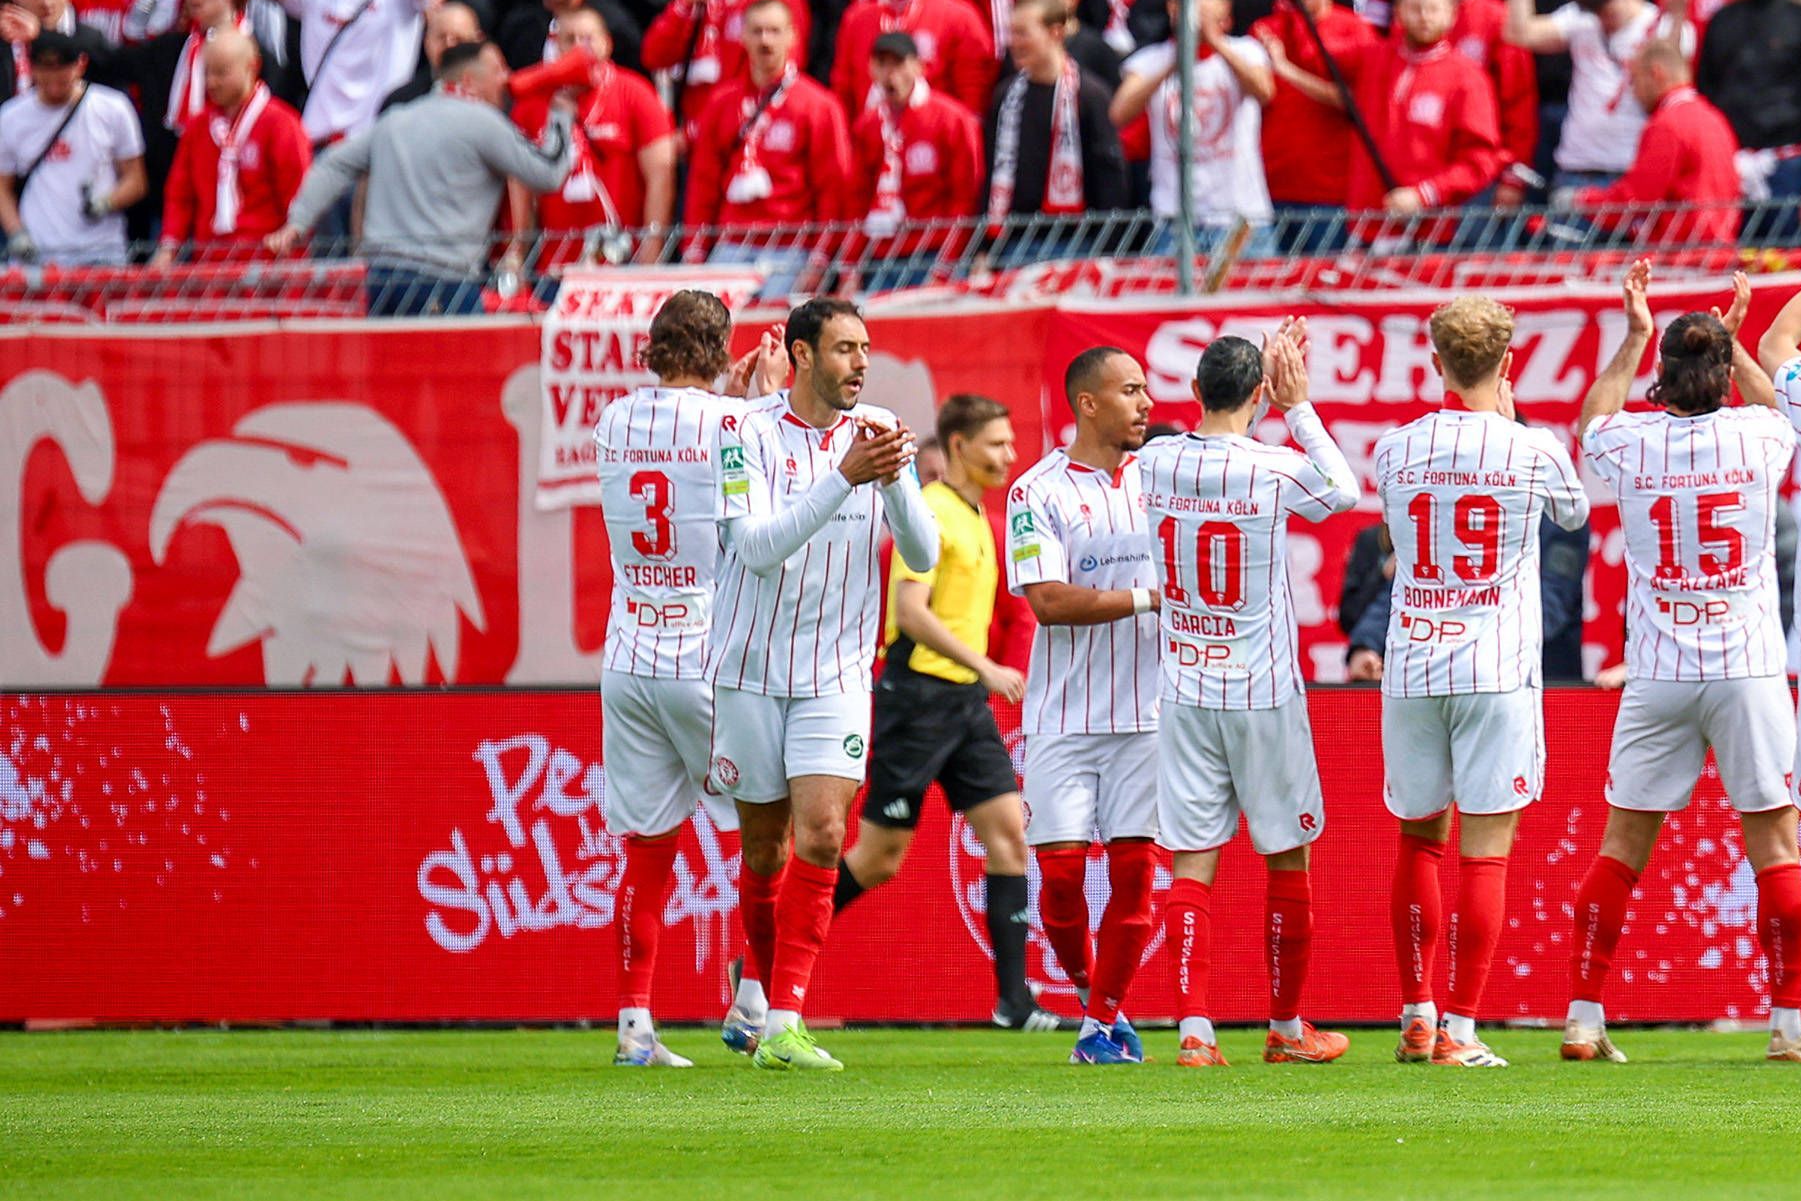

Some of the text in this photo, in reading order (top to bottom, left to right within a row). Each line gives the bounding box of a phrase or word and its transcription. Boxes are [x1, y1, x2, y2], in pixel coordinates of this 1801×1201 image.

[604, 449, 618, 463] S.C.
[622, 449, 673, 463] FORTUNA
[677, 446, 708, 463] KÖLN
[1397, 471, 1517, 487] S.C. FORTUNA KÖLN
[1634, 469, 1755, 490] S.C. FORTUNA KÖLN
[629, 469, 678, 563] 3
[1147, 493, 1259, 516] S.C. FORTUNA KÖLN
[1407, 491, 1507, 587] 19
[1648, 491, 1748, 579] 15
[1157, 515, 1248, 613] 10
[624, 565, 697, 588] FISCHER
[1404, 585, 1501, 609] BORNEMANN
[1171, 610, 1237, 637] GARCIA
